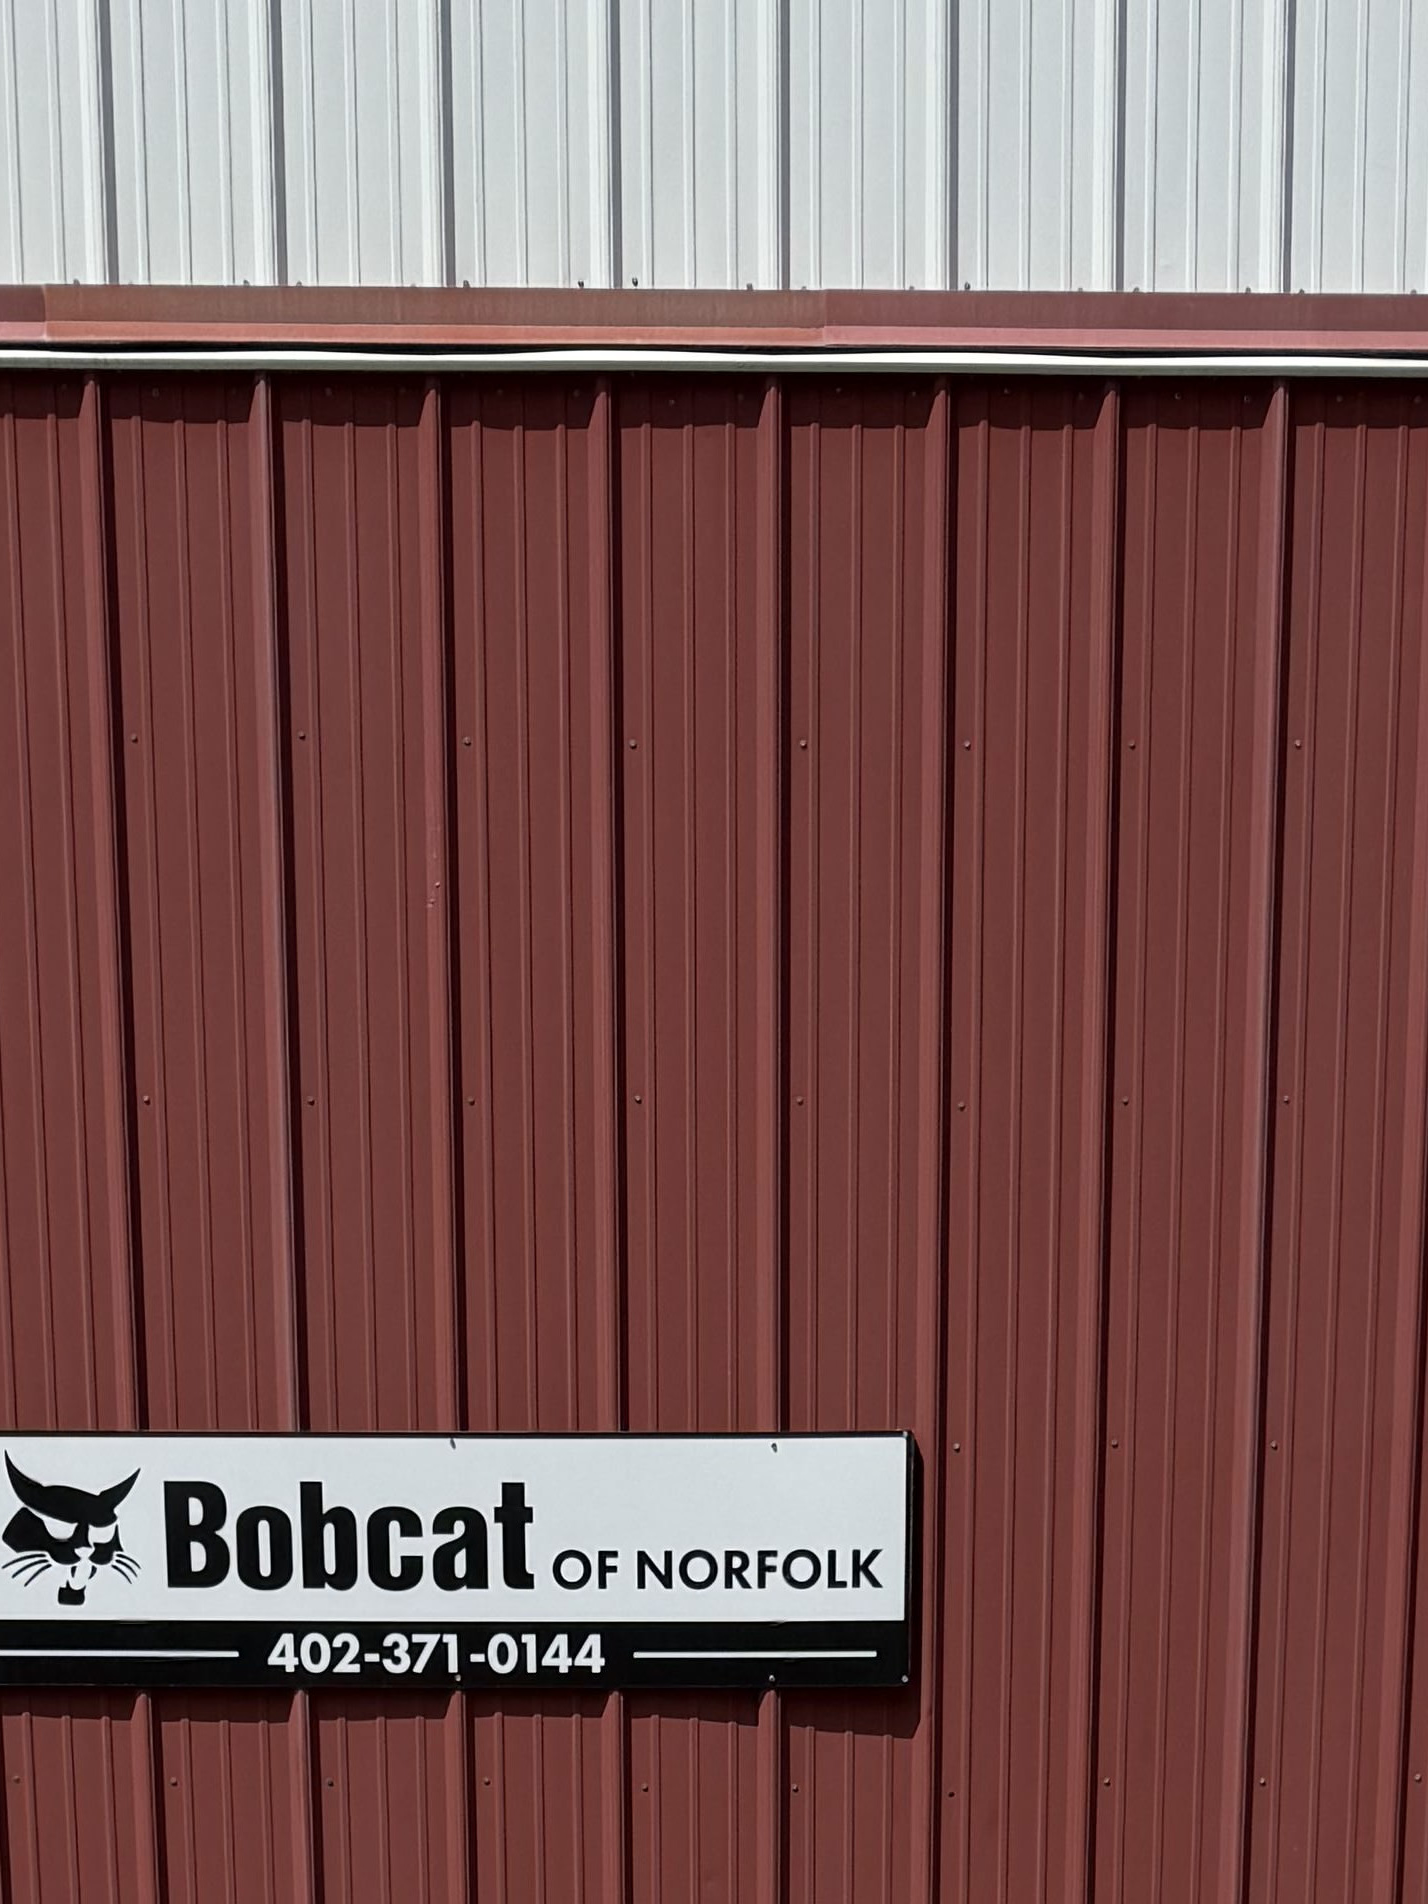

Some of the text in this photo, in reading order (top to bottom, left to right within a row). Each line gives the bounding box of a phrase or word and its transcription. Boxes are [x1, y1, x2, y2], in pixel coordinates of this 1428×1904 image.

[163, 1480, 883, 1592] Bobcat OF NORFOLK
[267, 1632, 606, 1674] 402-371-0144
